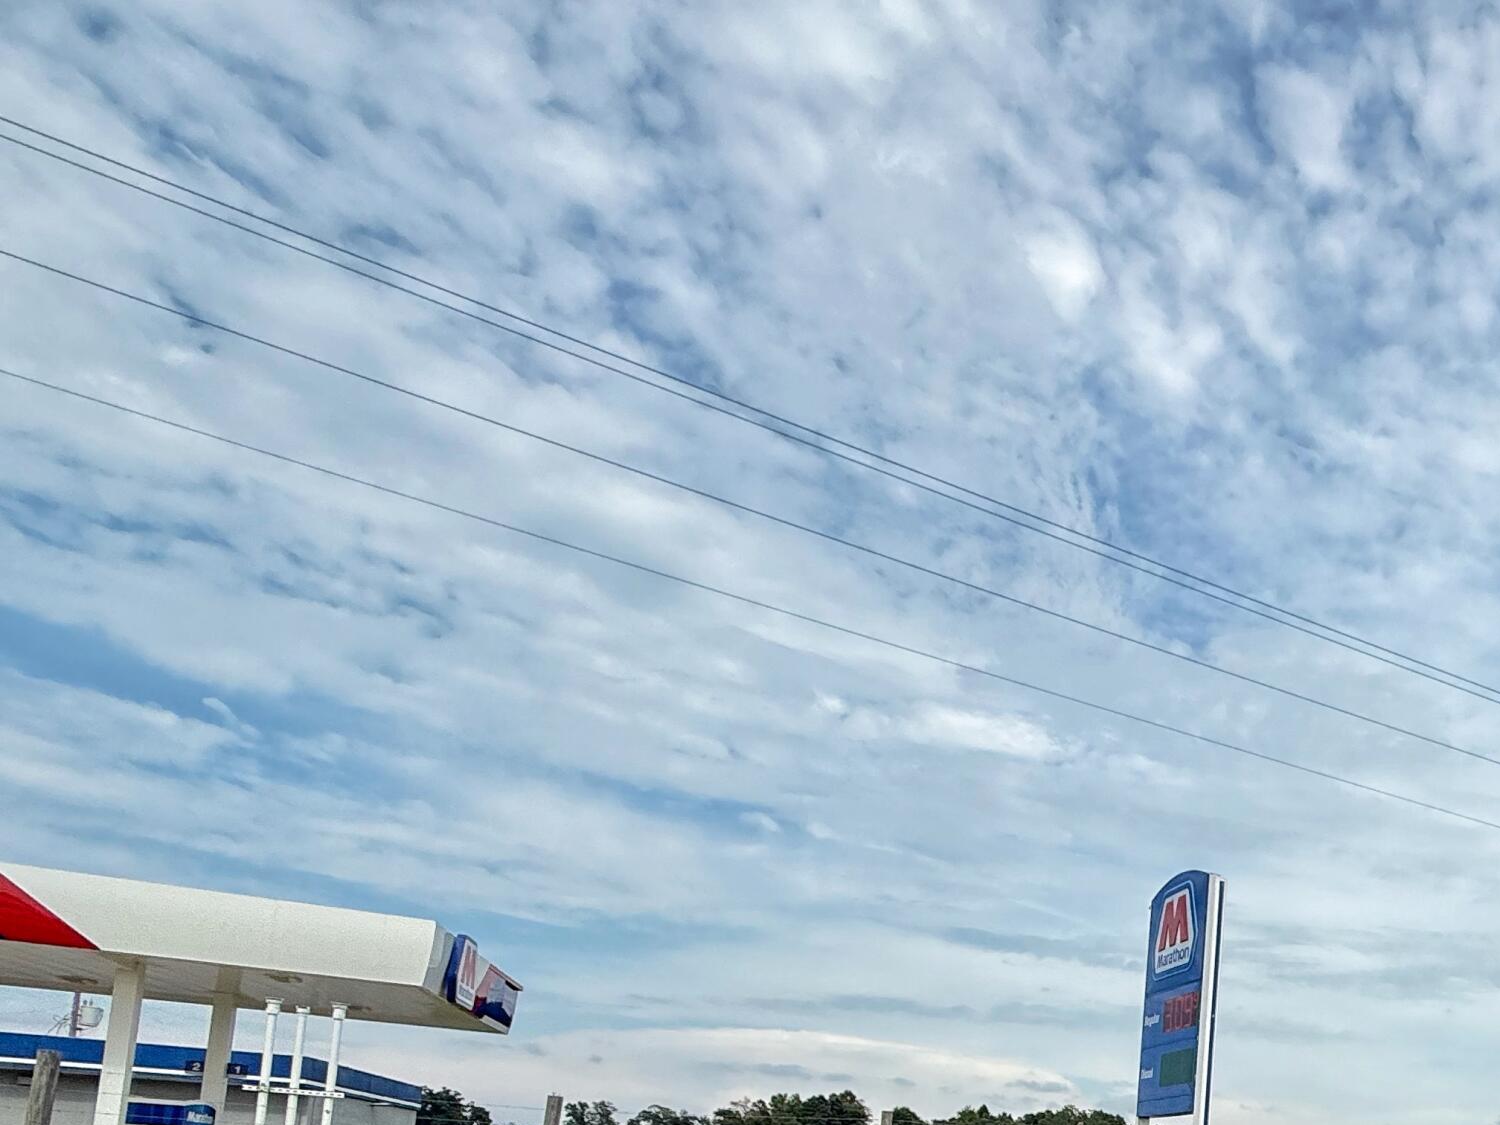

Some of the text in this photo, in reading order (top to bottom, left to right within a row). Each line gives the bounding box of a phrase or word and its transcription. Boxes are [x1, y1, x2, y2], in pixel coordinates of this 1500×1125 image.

[1158, 894, 1189, 953] M
[460, 945, 476, 990] M
[1157, 946, 1190, 968] Marathon
[191, 1062, 201, 1071] 2
[234, 1066, 241, 1074] 1
